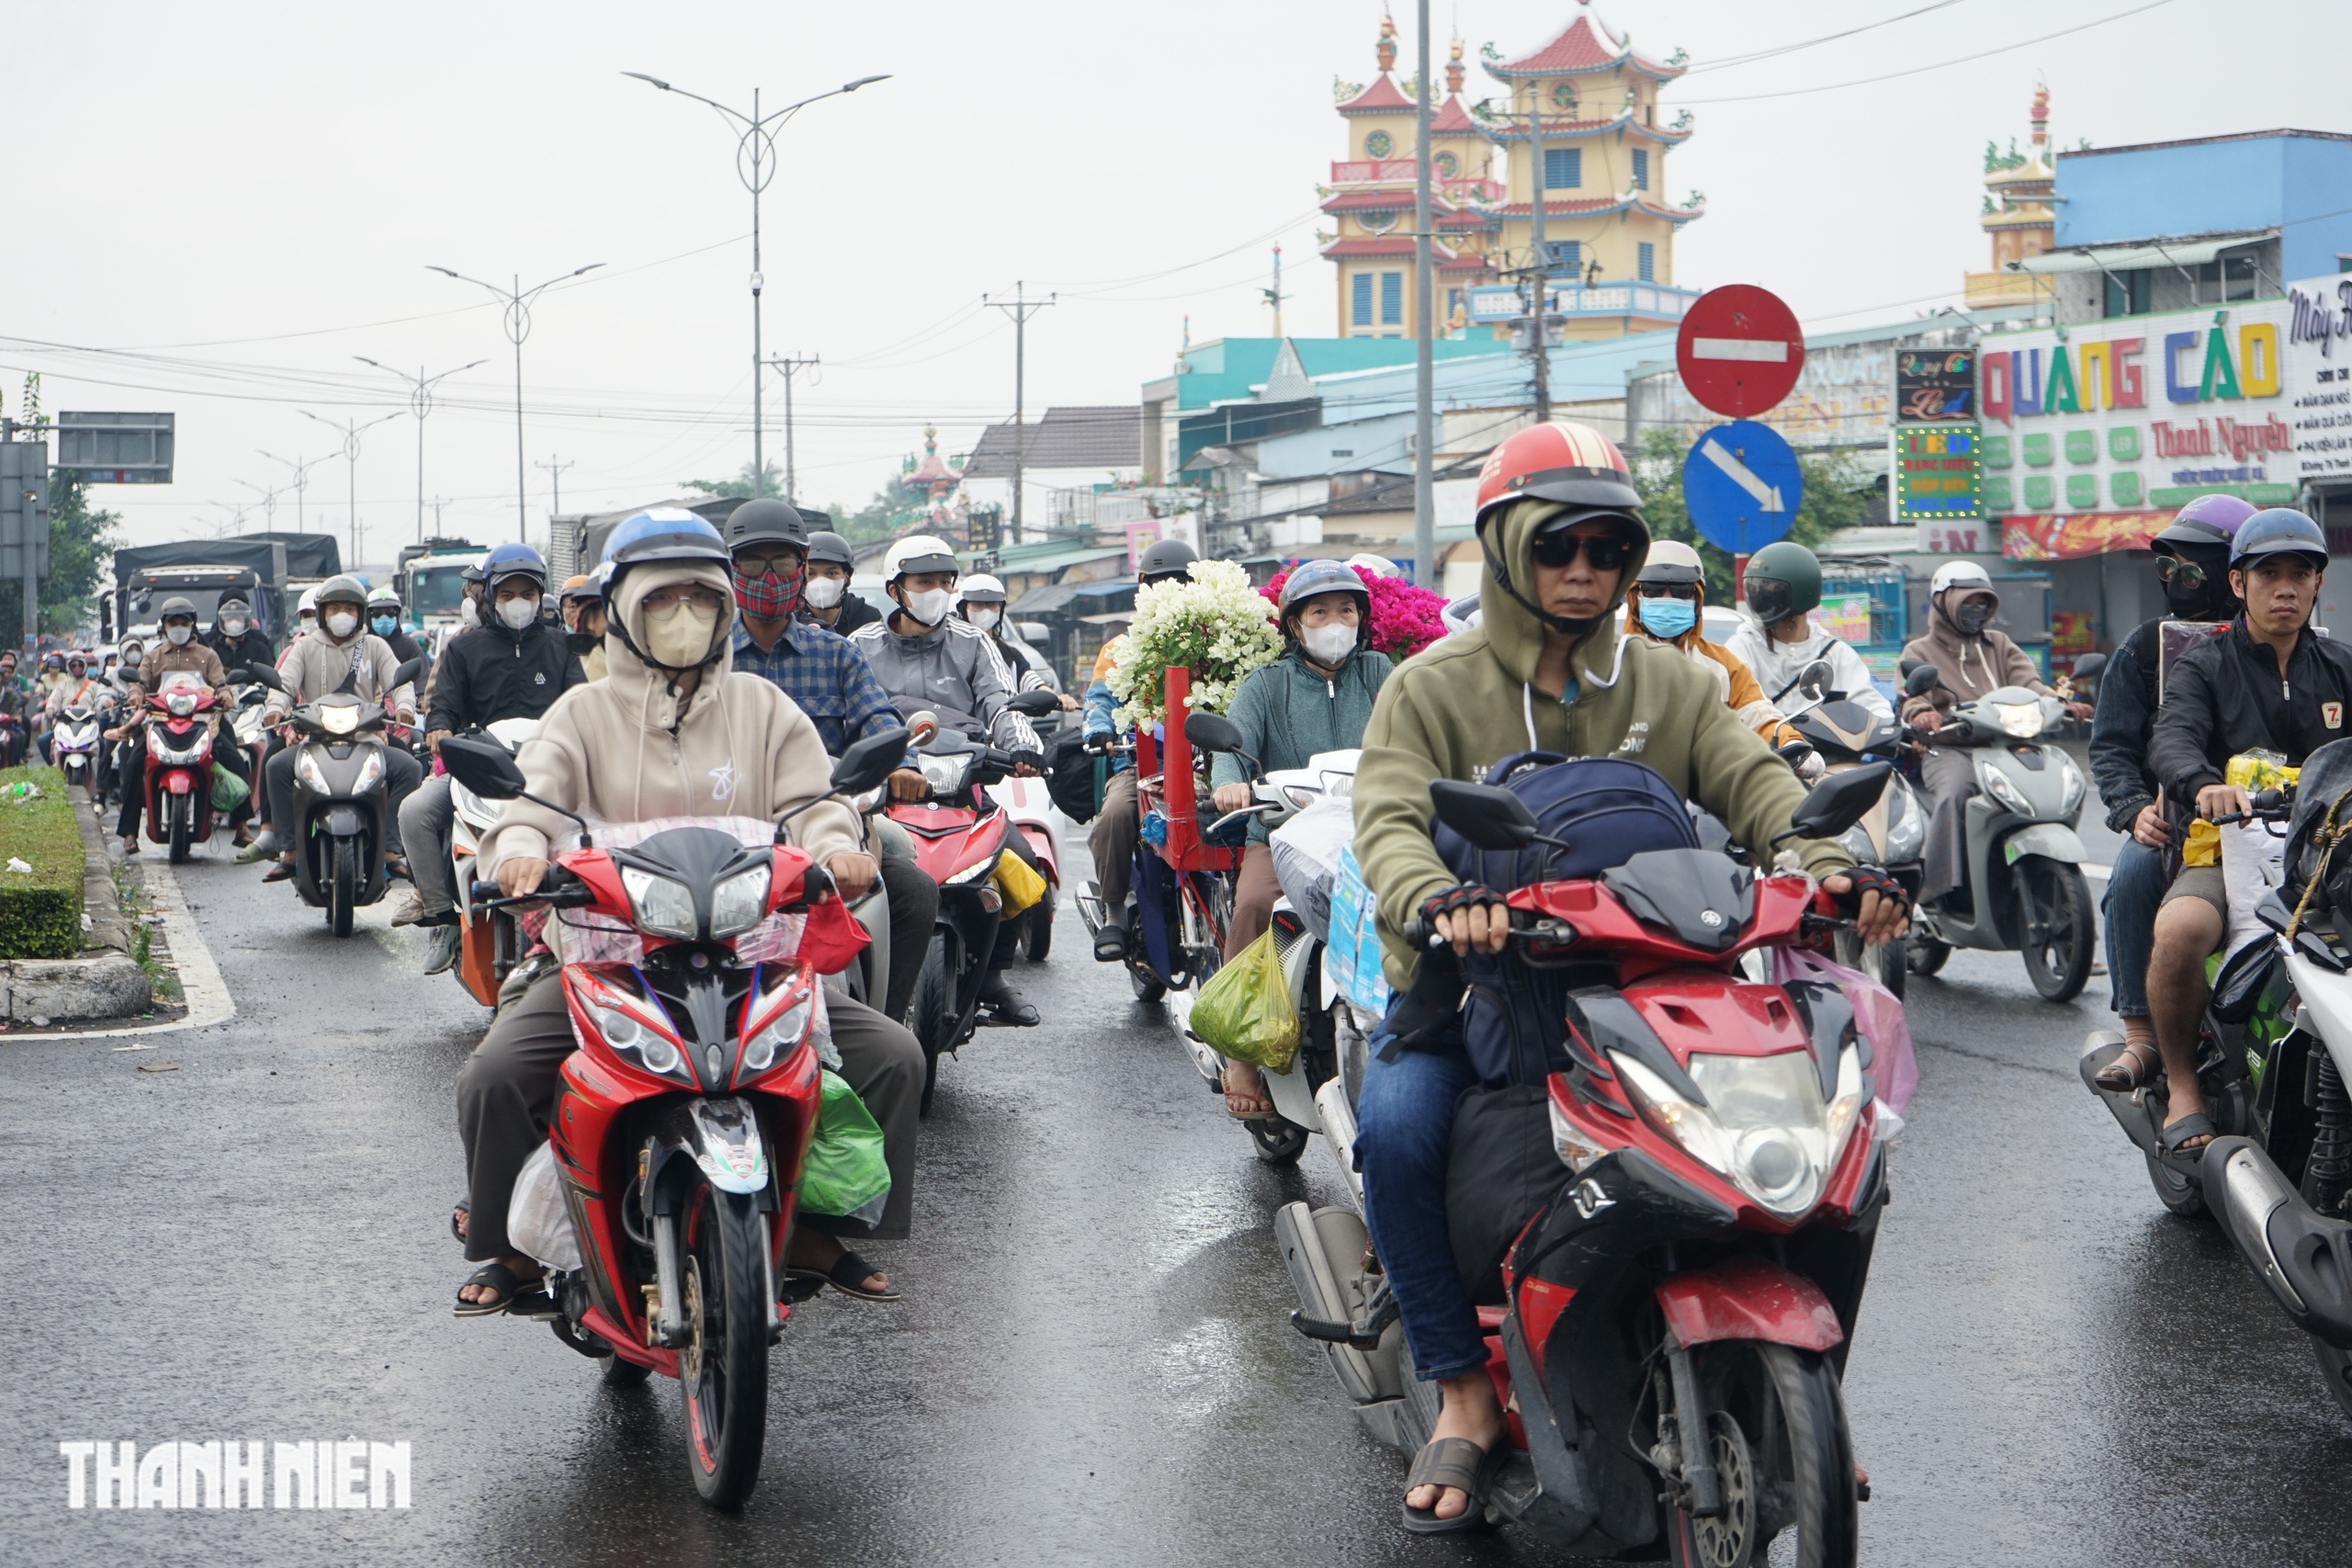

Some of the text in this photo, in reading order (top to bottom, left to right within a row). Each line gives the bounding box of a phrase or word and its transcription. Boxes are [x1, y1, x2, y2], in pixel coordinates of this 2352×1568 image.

[1983, 310, 2280, 429] QUẢNG CÁO
[1909, 434, 1970, 454] LED
[2152, 418, 2213, 457] Thanh
[1277, 915, 1295, 933] HONDA
